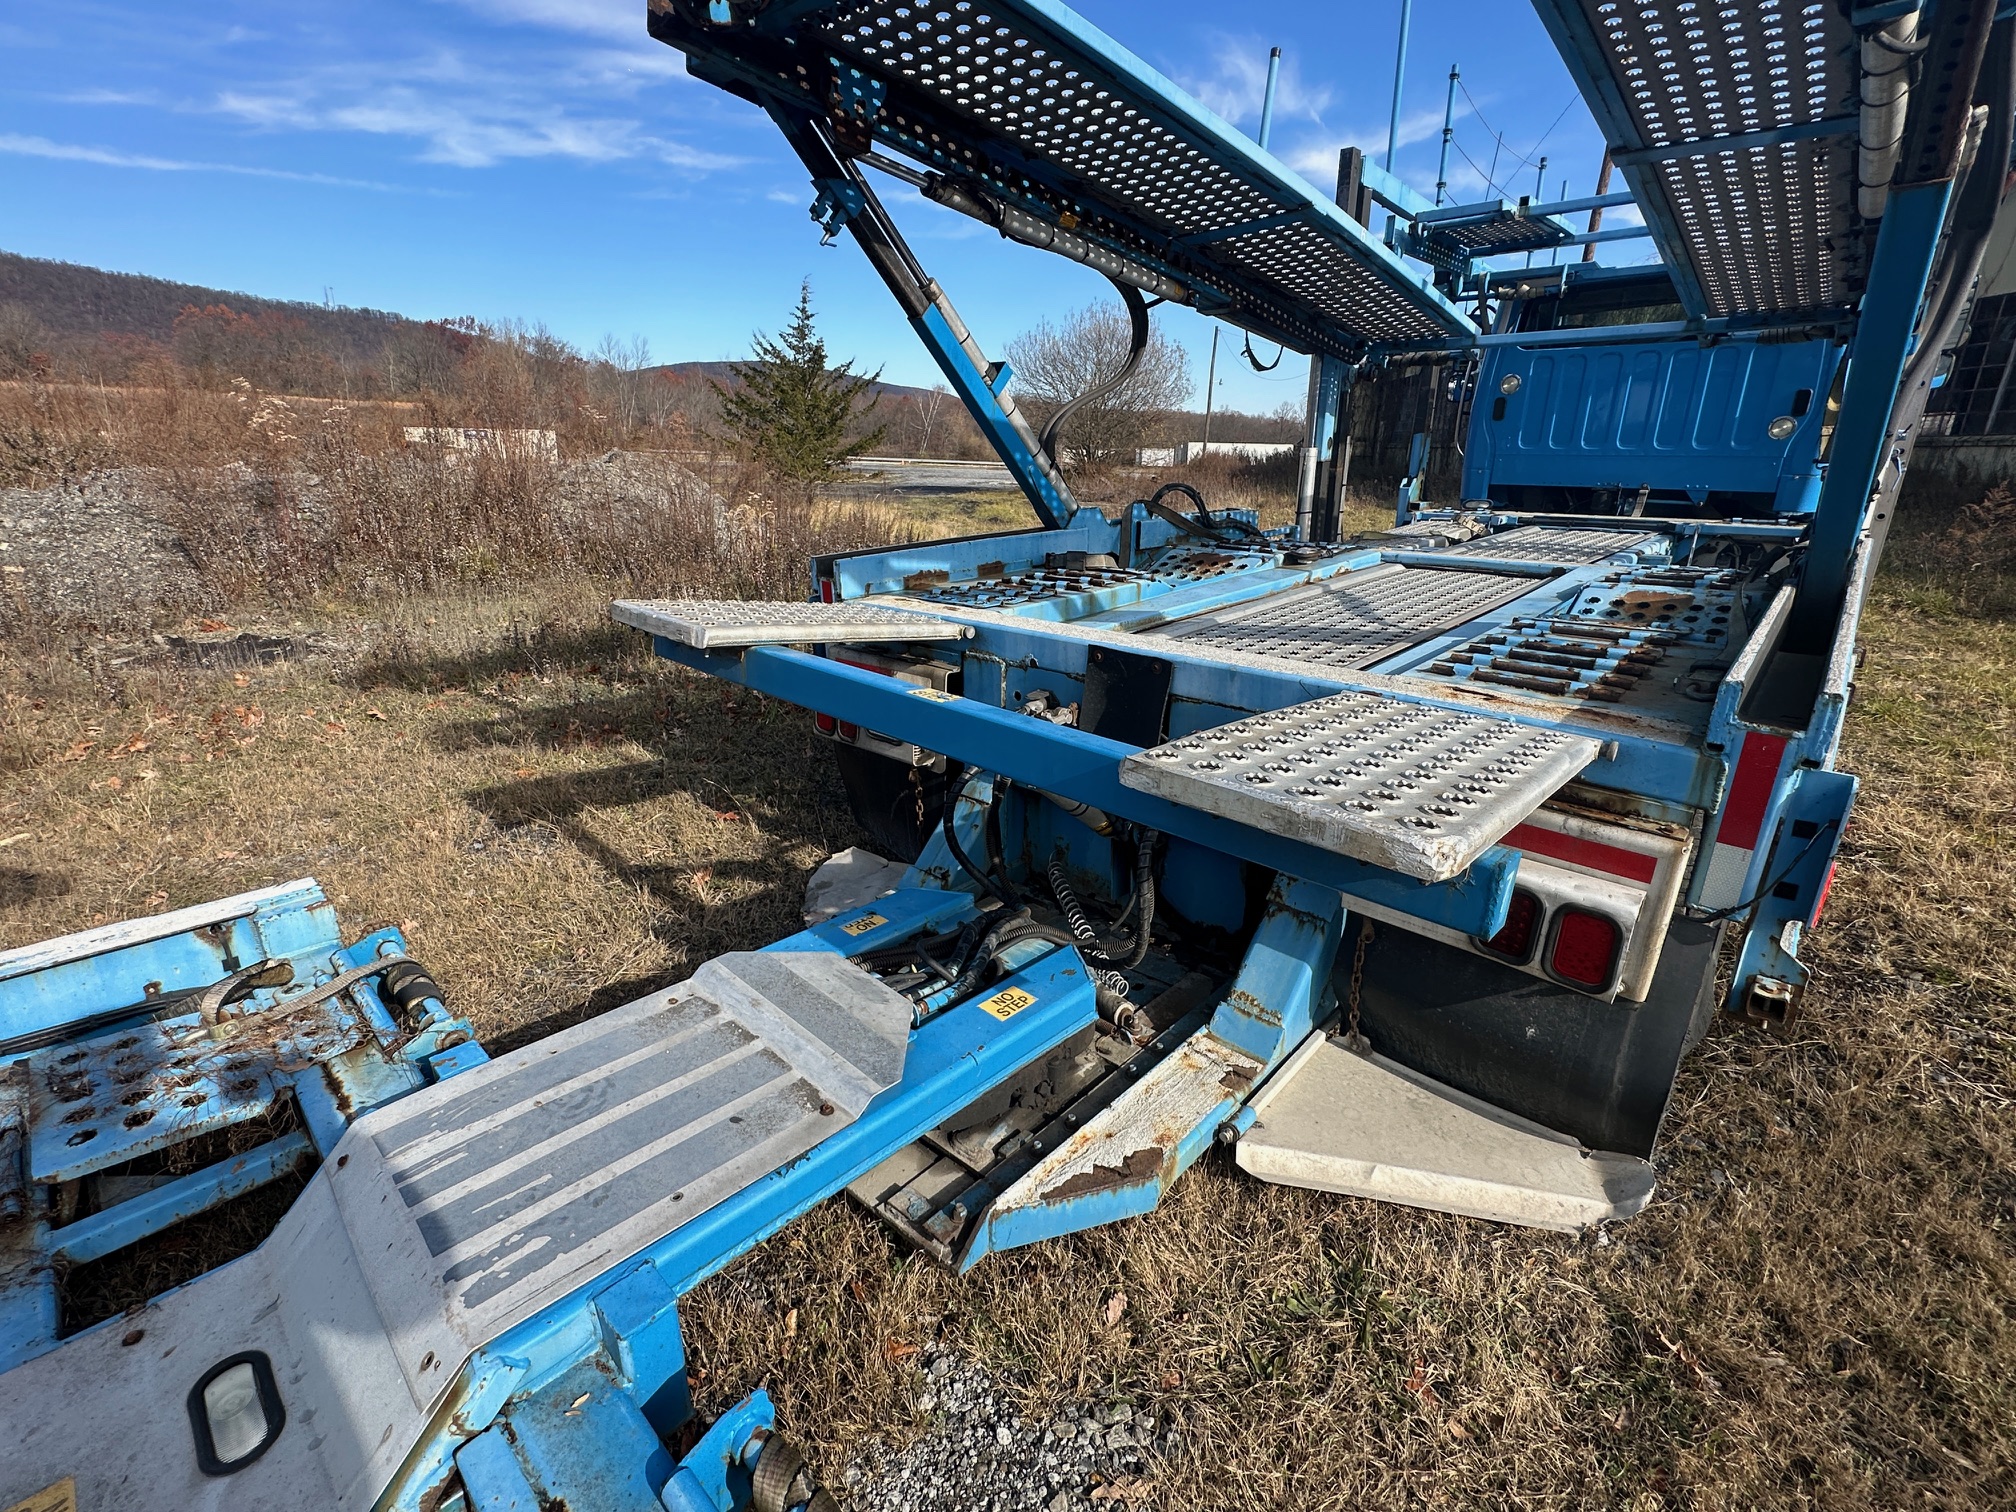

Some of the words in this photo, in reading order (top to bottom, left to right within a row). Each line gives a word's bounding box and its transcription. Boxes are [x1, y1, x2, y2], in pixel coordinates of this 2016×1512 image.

[856, 920, 877, 931] NO
[991, 993, 1014, 1006] NO
[996, 996, 1028, 1017] STEP
